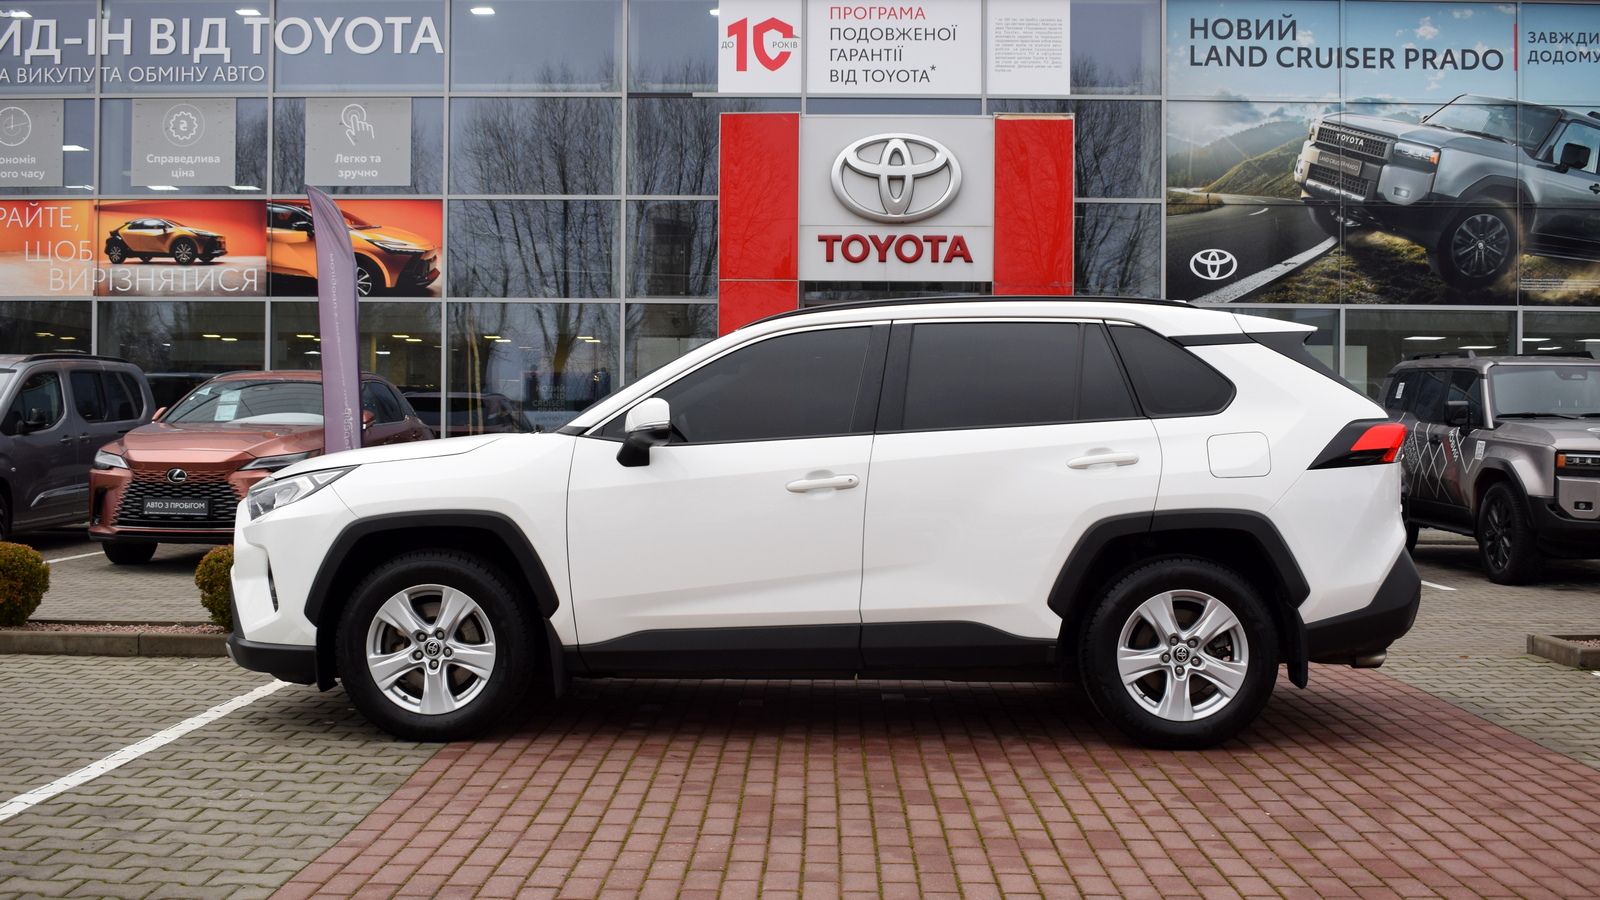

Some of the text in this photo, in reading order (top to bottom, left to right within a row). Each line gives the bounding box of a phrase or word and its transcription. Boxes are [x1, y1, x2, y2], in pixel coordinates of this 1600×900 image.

[829, 6, 926, 21] ПРОГРАМА
[829, 24, 958, 43] ПОДОВЖЕНОЇ
[1190, 13, 1297, 41] НОВИЙ
[150, 17, 231, 64] ВІД
[244, 16, 444, 55] TOYOTA
[721, 41, 735, 49] ДО
[772, 41, 798, 49] РОКІВ
[1527, 31, 1599, 47] ЗАВЖДИ
[829, 45, 904, 62] ГАРАНТІЇ
[1190, 45, 1504, 71] LAND CRUISER PRADO
[1527, 50, 1600, 65] ДОДОМУ
[17, 67, 96, 84] ВИКУПУ
[101, 66, 123, 83] ТА
[128, 66, 208, 83] ОБМІНУ
[213, 65, 265, 83] АВТО
[829, 69, 858, 85] ВІД
[1336, 133, 1364, 146] TOYOTA
[146, 154, 221, 165] Справедлива
[335, 154, 382, 164] Легко та
[21, 170, 45, 180] часу
[171, 167, 195, 178] ціна
[338, 168, 378, 178] зручно
[25, 240, 93, 266] ЩОБ
[818, 234, 973, 264] TOYOTA
[49, 268, 258, 291] ВИРІЗНЯТИСЯ
